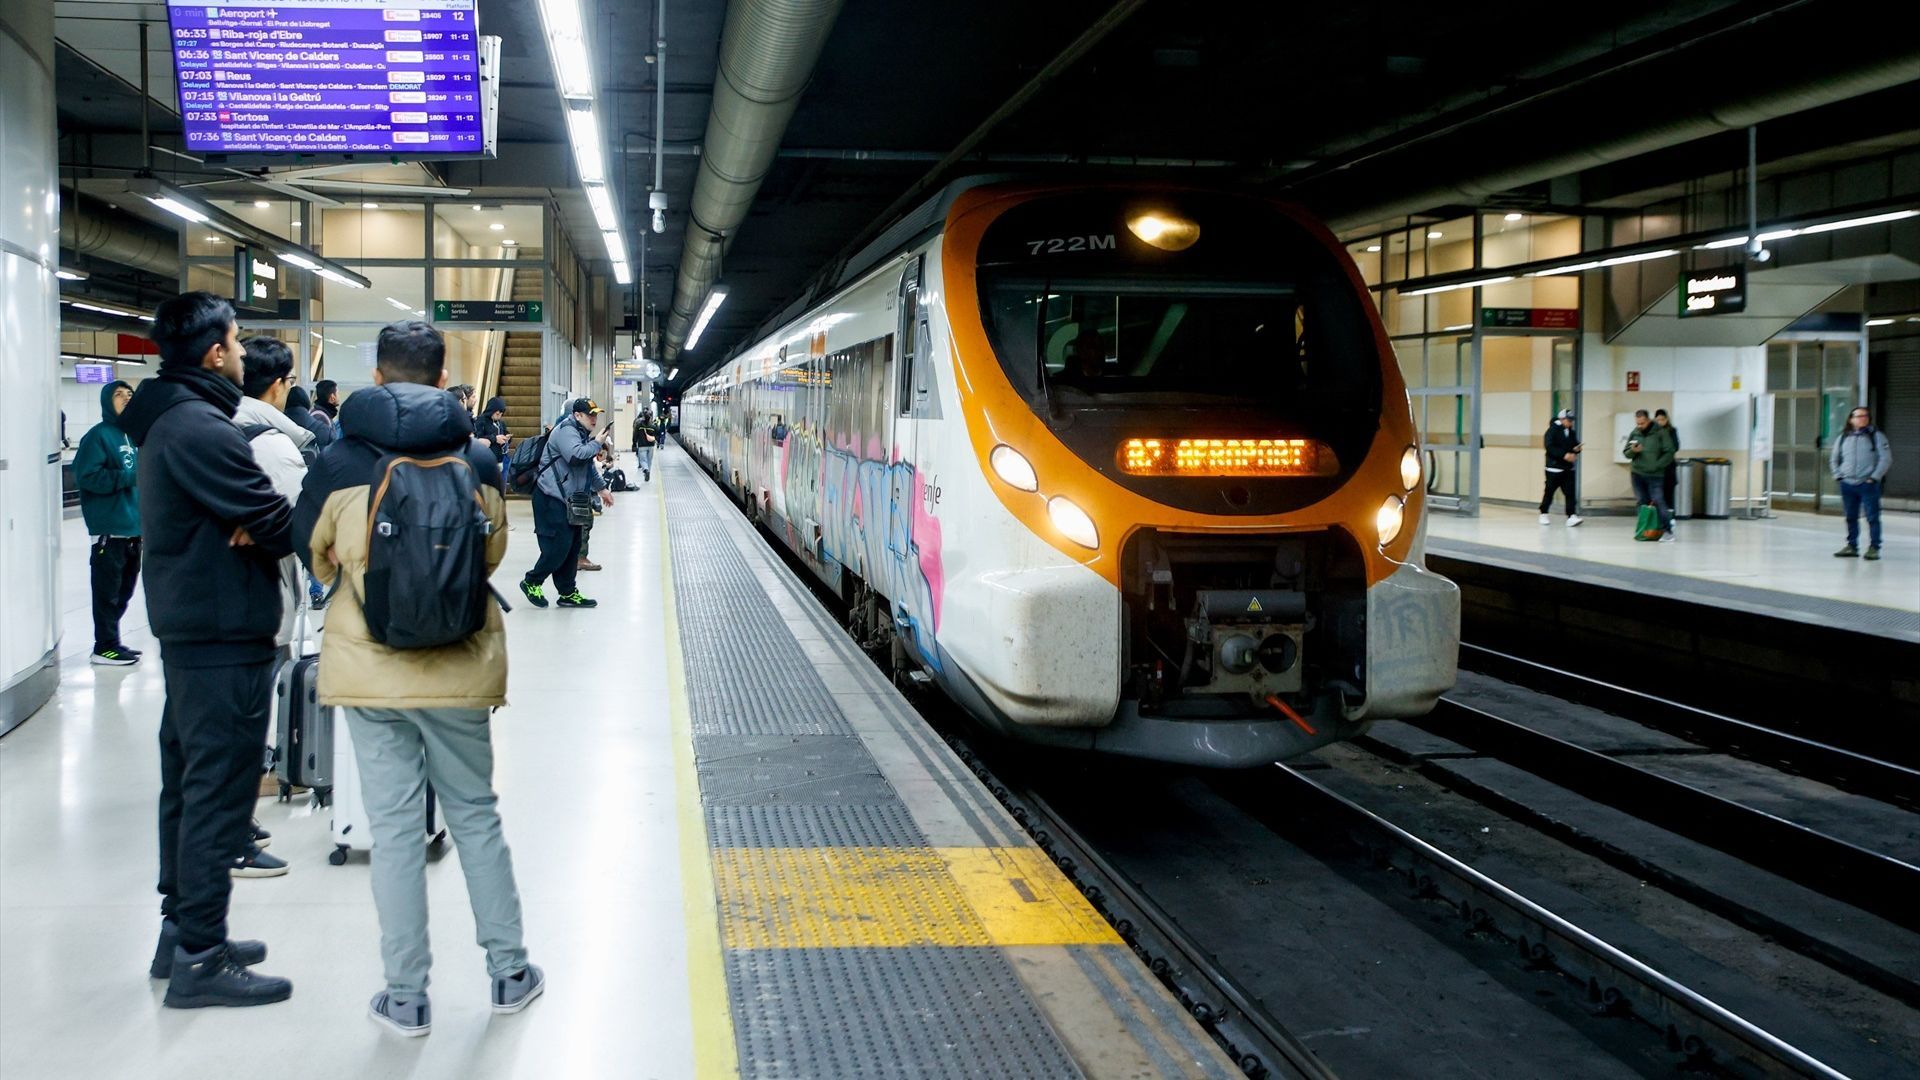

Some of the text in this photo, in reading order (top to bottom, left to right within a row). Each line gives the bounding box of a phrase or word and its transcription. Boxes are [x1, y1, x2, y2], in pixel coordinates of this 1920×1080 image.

[220, 9, 265, 19] Aeroport
[453, 12, 464, 20] 12
[175, 29, 206, 38] 06:33
[221, 30, 268, 40] Riba-roja
[270, 30, 302, 40] d'Ebre
[180, 50, 210, 59] 06:36
[224, 51, 248, 60] Sant
[249, 51, 284, 62] Vicenç
[285, 52, 298, 60] de
[300, 52, 339, 61] Calders
[182, 71, 212, 80] 07:03
[226, 72, 252, 80] Reus
[185, 92, 214, 100] 07:15
[229, 92, 272, 101] Vilanova
[278, 92, 288, 102] la
[289, 92, 322, 102] Geltrú
[188, 112, 218, 121] 07:33
[232, 113, 270, 121] Tortosa
[190, 132, 220, 141] 07:36
[234, 133, 258, 142] Sant
[258, 133, 292, 143] Vicenç
[294, 134, 307, 142] de
[308, 134, 346, 142] Calders
[1027, 234, 1116, 255] 722M
